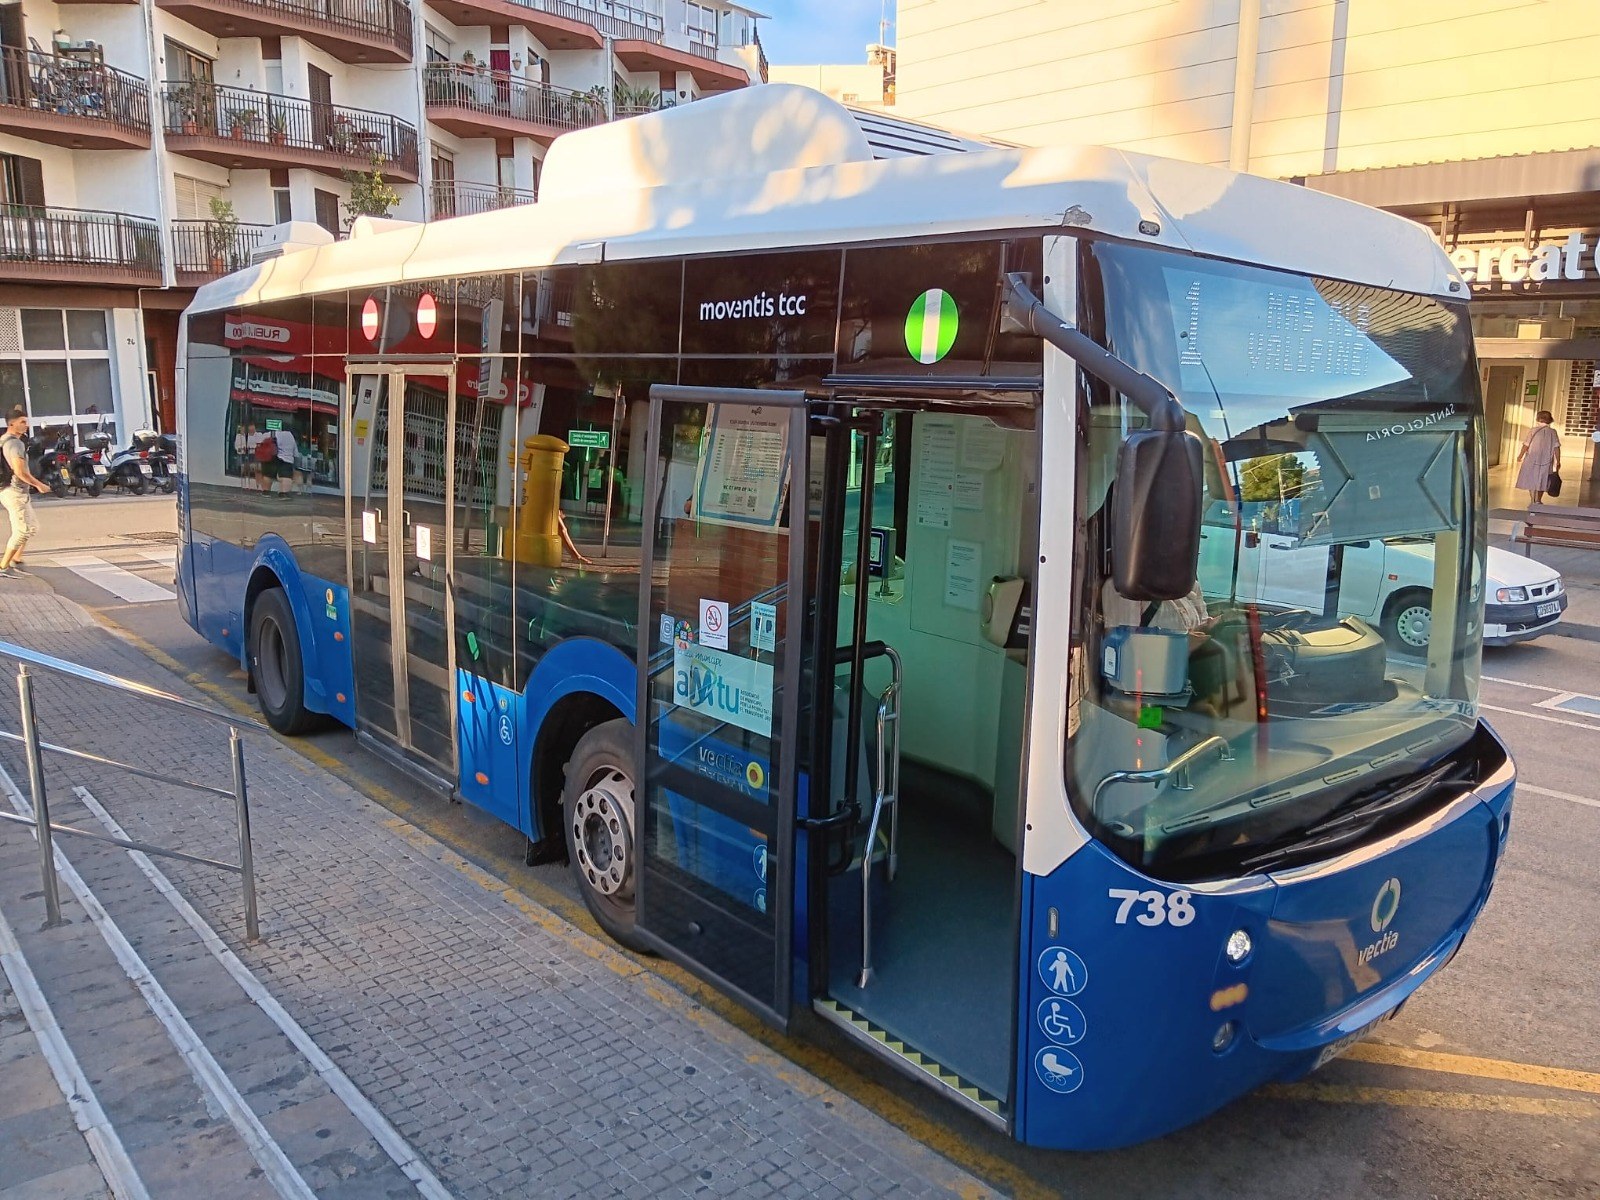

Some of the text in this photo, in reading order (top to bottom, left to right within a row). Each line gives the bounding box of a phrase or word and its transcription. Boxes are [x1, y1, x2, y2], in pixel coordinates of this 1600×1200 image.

[1449, 232, 1588, 282] ercat
[700, 291, 806, 320] moventis tcc
[1180, 282, 1201, 365] 1
[1248, 333, 1369, 376] VALLPINE
[1109, 888, 1196, 926] 738
[1358, 930, 1399, 966] vectia
